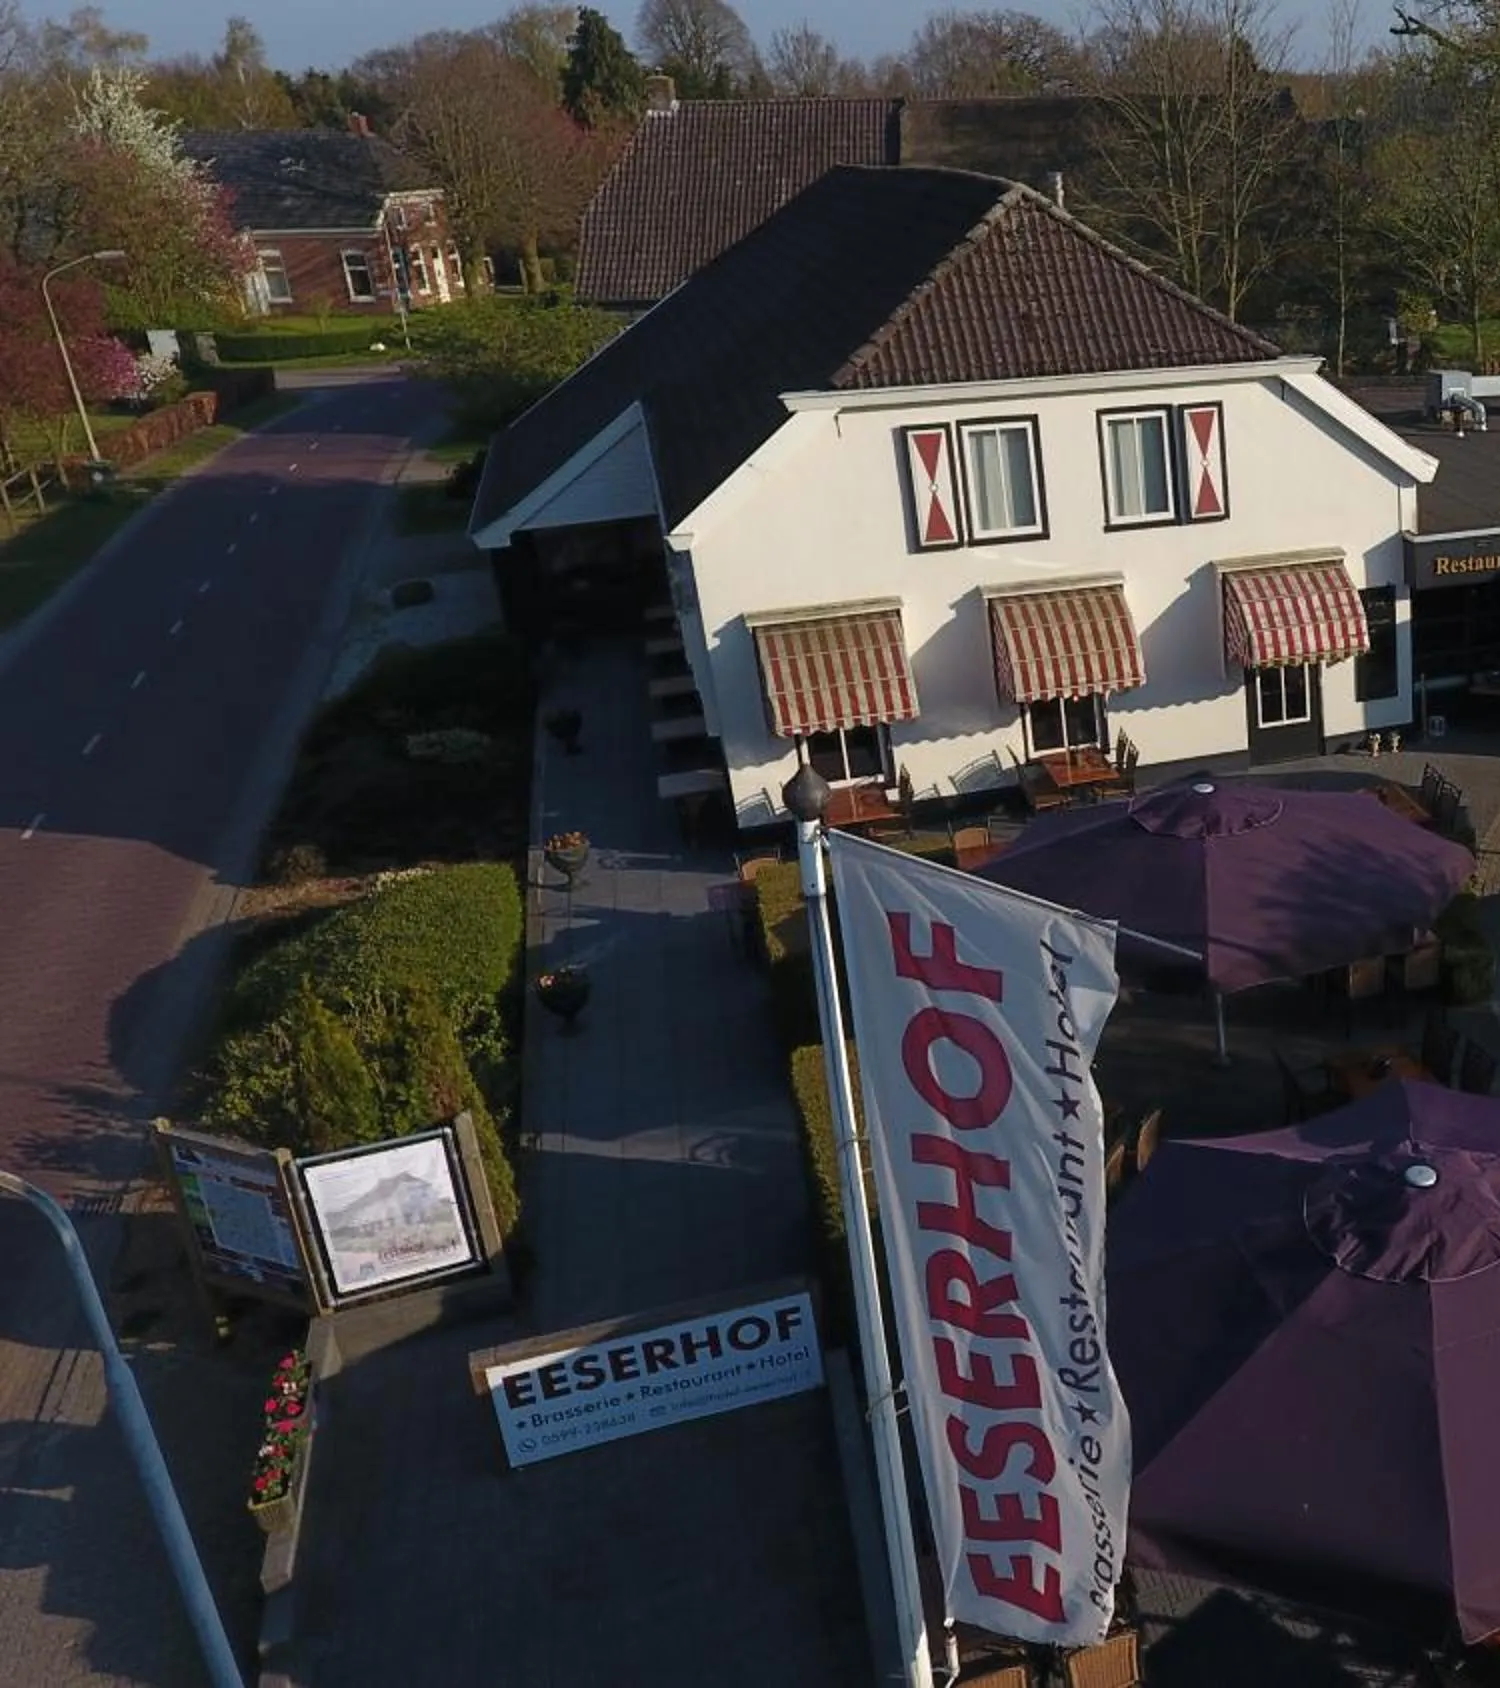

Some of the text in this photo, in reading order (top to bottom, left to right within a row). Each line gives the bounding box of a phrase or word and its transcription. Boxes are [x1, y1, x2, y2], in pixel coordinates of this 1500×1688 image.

[886, 911, 1067, 1624] EESERHOF
[502, 1306, 801, 1408] EESERHOF
[530, 1393, 622, 1428] Brasserie
[640, 1364, 742, 1399] Restaurant
[759, 1345, 809, 1370] Hotel
